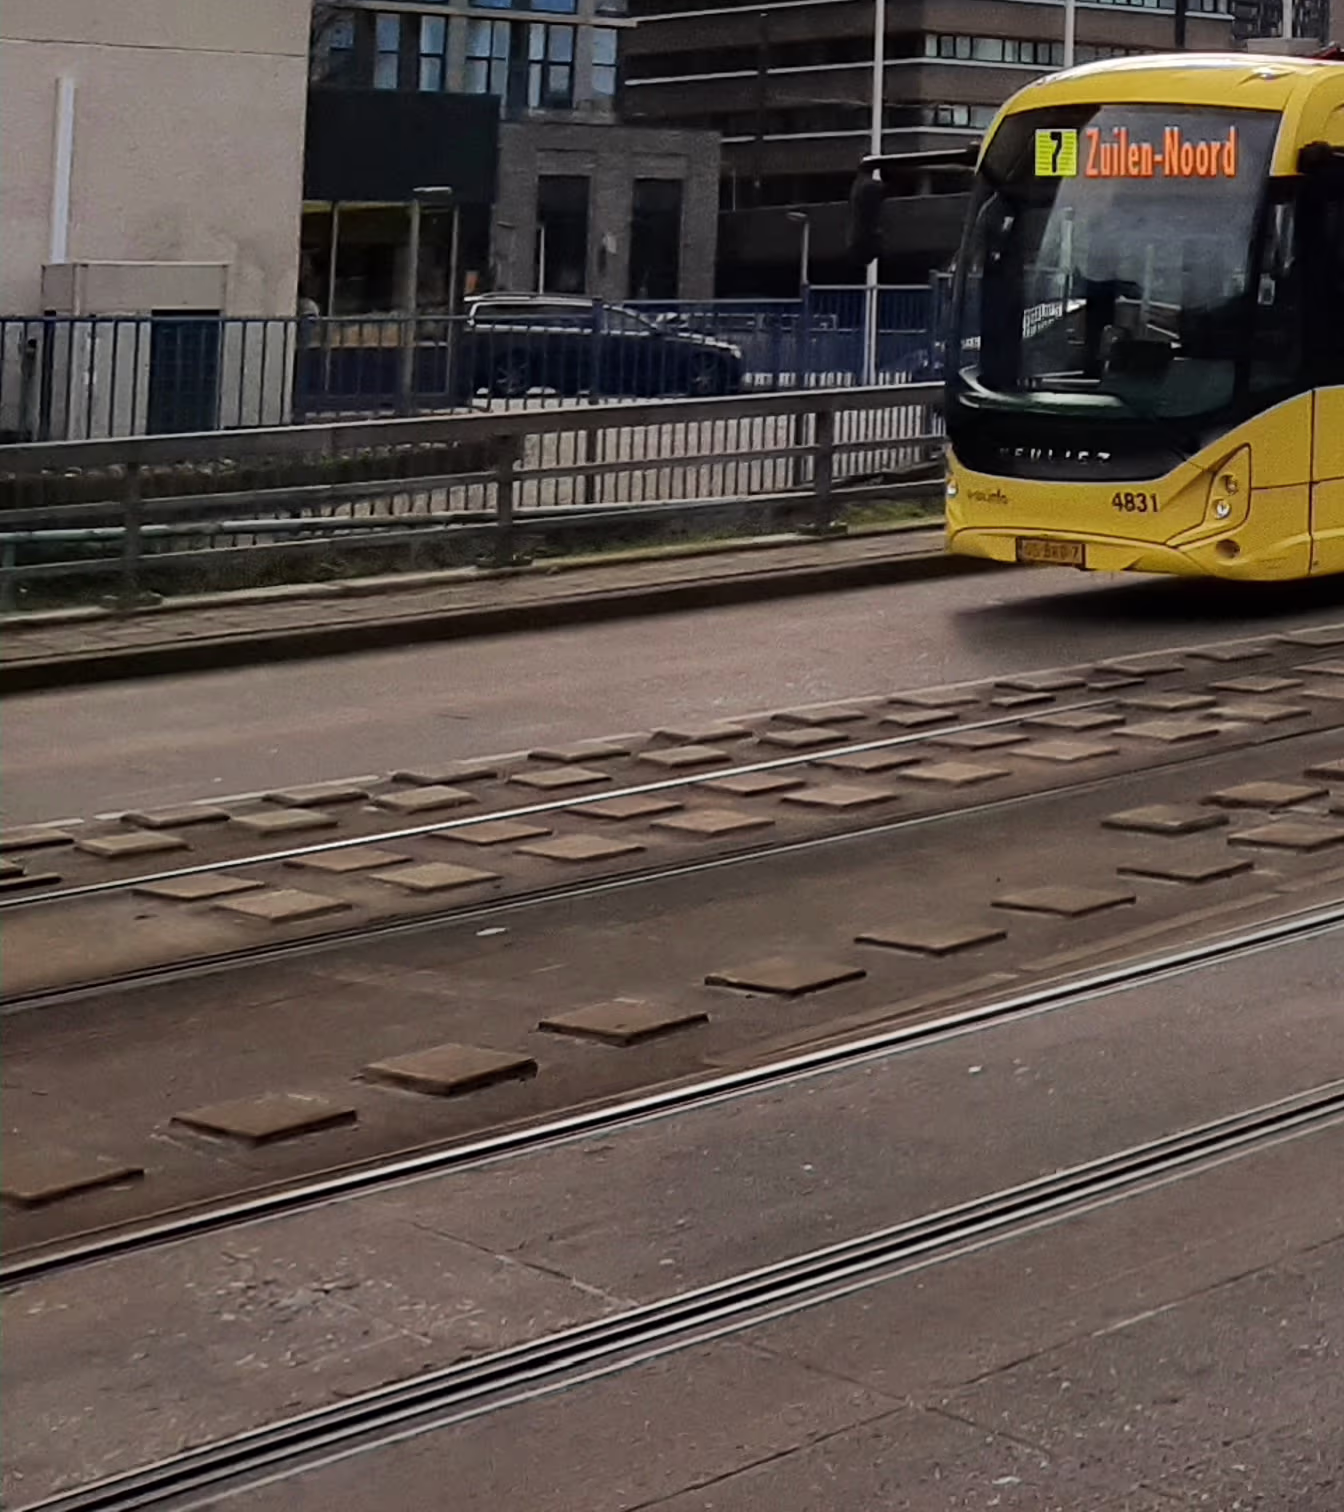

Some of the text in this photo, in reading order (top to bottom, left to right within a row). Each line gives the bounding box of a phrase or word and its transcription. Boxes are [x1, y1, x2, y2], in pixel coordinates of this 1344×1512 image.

[1050, 126, 1239, 178] 7 Zuilen-Noord
[1111, 491, 1160, 514] 4831
